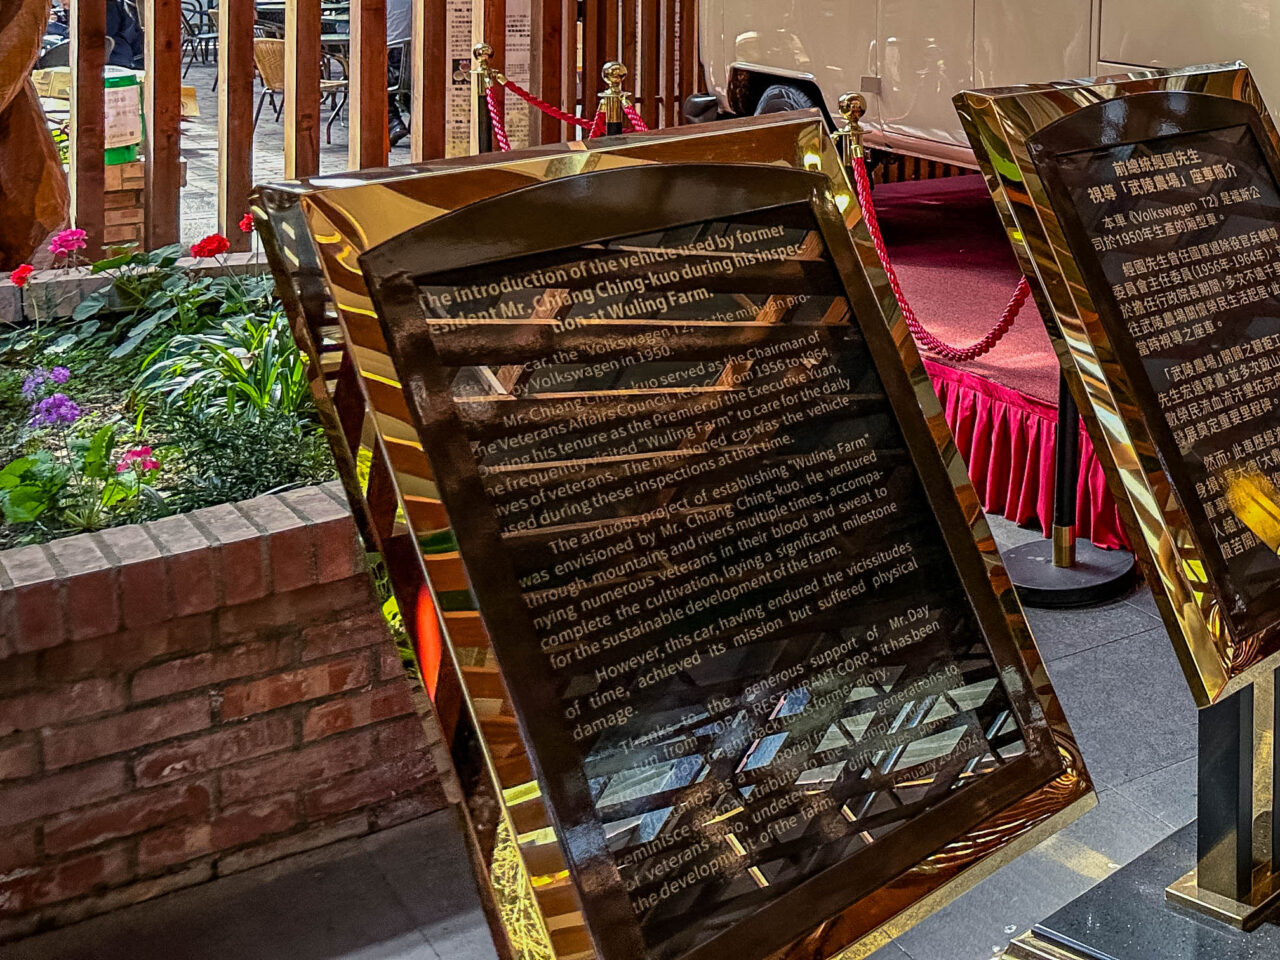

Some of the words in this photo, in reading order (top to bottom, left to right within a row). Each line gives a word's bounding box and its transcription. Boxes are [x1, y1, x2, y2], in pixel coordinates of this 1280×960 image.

[1112, 148, 1202, 177] 前總統經國先生
[452, 265, 568, 302] introduction
[588, 255, 618, 274] the
[617, 243, 677, 268] vehicle
[677, 236, 715, 256] used
[735, 222, 786, 244] former
[499, 299, 531, 318] Mr.
[531, 284, 595, 315] Chiang
[594, 266, 681, 301] Ching-kuo
[679, 255, 734, 282] during
[732, 250, 756, 267] his
[756, 240, 808, 265] inspec-
[607, 293, 668, 323] Wuling
[667, 284, 714, 306] Farm.
[525, 356, 620, 394] Volkswagen
[636, 343, 674, 362] 1950.
[551, 347, 578, 364] the
[786, 294, 812, 309] pro-
[497, 420, 567, 450] Veterans
[566, 405, 615, 430] Affairs
[615, 388, 676, 418] Council,
[755, 359, 785, 376] 1956
[503, 411, 528, 427] Mr.
[528, 395, 583, 423] Chiang
[658, 361, 705, 385] served
[745, 334, 807, 361] Chairman
[530, 443, 556, 461] his
[557, 430, 608, 454] tenure
[626, 415, 651, 433] the
[652, 399, 710, 426] Premier
[723, 388, 747, 405] the
[747, 371, 807, 398] Executive
[807, 361, 841, 381] Yuan,
[505, 456, 587, 494] frequently
[752, 400, 780, 415] care
[779, 391, 799, 407] for
[799, 384, 821, 401] the
[820, 375, 852, 396] daily
[538, 496, 592, 527] during
[590, 482, 634, 507] these
[634, 457, 717, 496] inspections
[731, 442, 759, 461] that
[760, 432, 794, 452] time.
[546, 469, 618, 500] veterans.
[623, 456, 650, 476] The
[651, 432, 727, 467] mentioned
[732, 428, 751, 441] car
[754, 420, 779, 434] was
[781, 408, 804, 425] the
[805, 394, 850, 417] vehicle
[519, 570, 550, 588] was
[552, 536, 634, 576] envisioned
[659, 520, 682, 537] Mr.
[685, 501, 735, 531] Chiang
[735, 476, 804, 513] Ching-kuo.
[825, 450, 877, 478] ventured
[524, 575, 588, 612] through
[591, 546, 669, 584] mountains
[668, 535, 696, 555] and
[696, 522, 734, 545] rivers
[734, 501, 789, 533] multiple
[828, 469, 885, 499] accompa-
[548, 533, 578, 554] The
[578, 512, 639, 544] arduous
[640, 497, 690, 525] project
[710, 462, 789, 501] establishing
[532, 602, 577, 632] nying
[579, 575, 655, 611] numerous
[656, 550, 717, 581] veterans
[736, 529, 769, 551] their
[770, 514, 808, 538] blood
[811, 504, 835, 522] and
[838, 492, 872, 512] sweat
[538, 610, 613, 653] complete
[614, 599, 640, 620] the
[643, 567, 723, 610] cultivation,
[722, 552, 764, 580] laying
[774, 522, 840, 560] significant
[841, 500, 897, 531] milestone
[549, 649, 573, 669] for
[573, 638, 600, 660] the
[600, 605, 684, 649] sustainable
[683, 570, 773, 618] development
[786, 555, 808, 574] the
[808, 542, 842, 565] farm.
[589, 682, 630, 711] time,
[636, 650, 701, 688] achieved
[707, 640, 726, 657] its
[732, 616, 784, 647] mission
[788, 602, 812, 622] but
[816, 579, 866, 610] suffered
[871, 557, 919, 589] physical
[594, 644, 665, 685] However,
[664, 631, 692, 653] this
[693, 624, 719, 643] car,
[718, 601, 766, 633] having
[766, 578, 819, 610] endured
[822, 568, 843, 587] the
[844, 540, 912, 577] vicissitudes
[571, 700, 639, 743] damage.
[662, 732, 698, 759] from
[889, 631, 912, 651] has
[911, 618, 940, 641] been
[705, 694, 731, 715] the
[744, 664, 805, 701] generous
[809, 637, 859, 670] support
[747, 715, 780, 741] back
[811, 680, 853, 710] former
[855, 663, 890, 691] glory.
[753, 764, 798, 797] tribute
[631, 889, 658, 914] the
[774, 813, 797, 836] the
[644, 837, 709, 880] veterans
